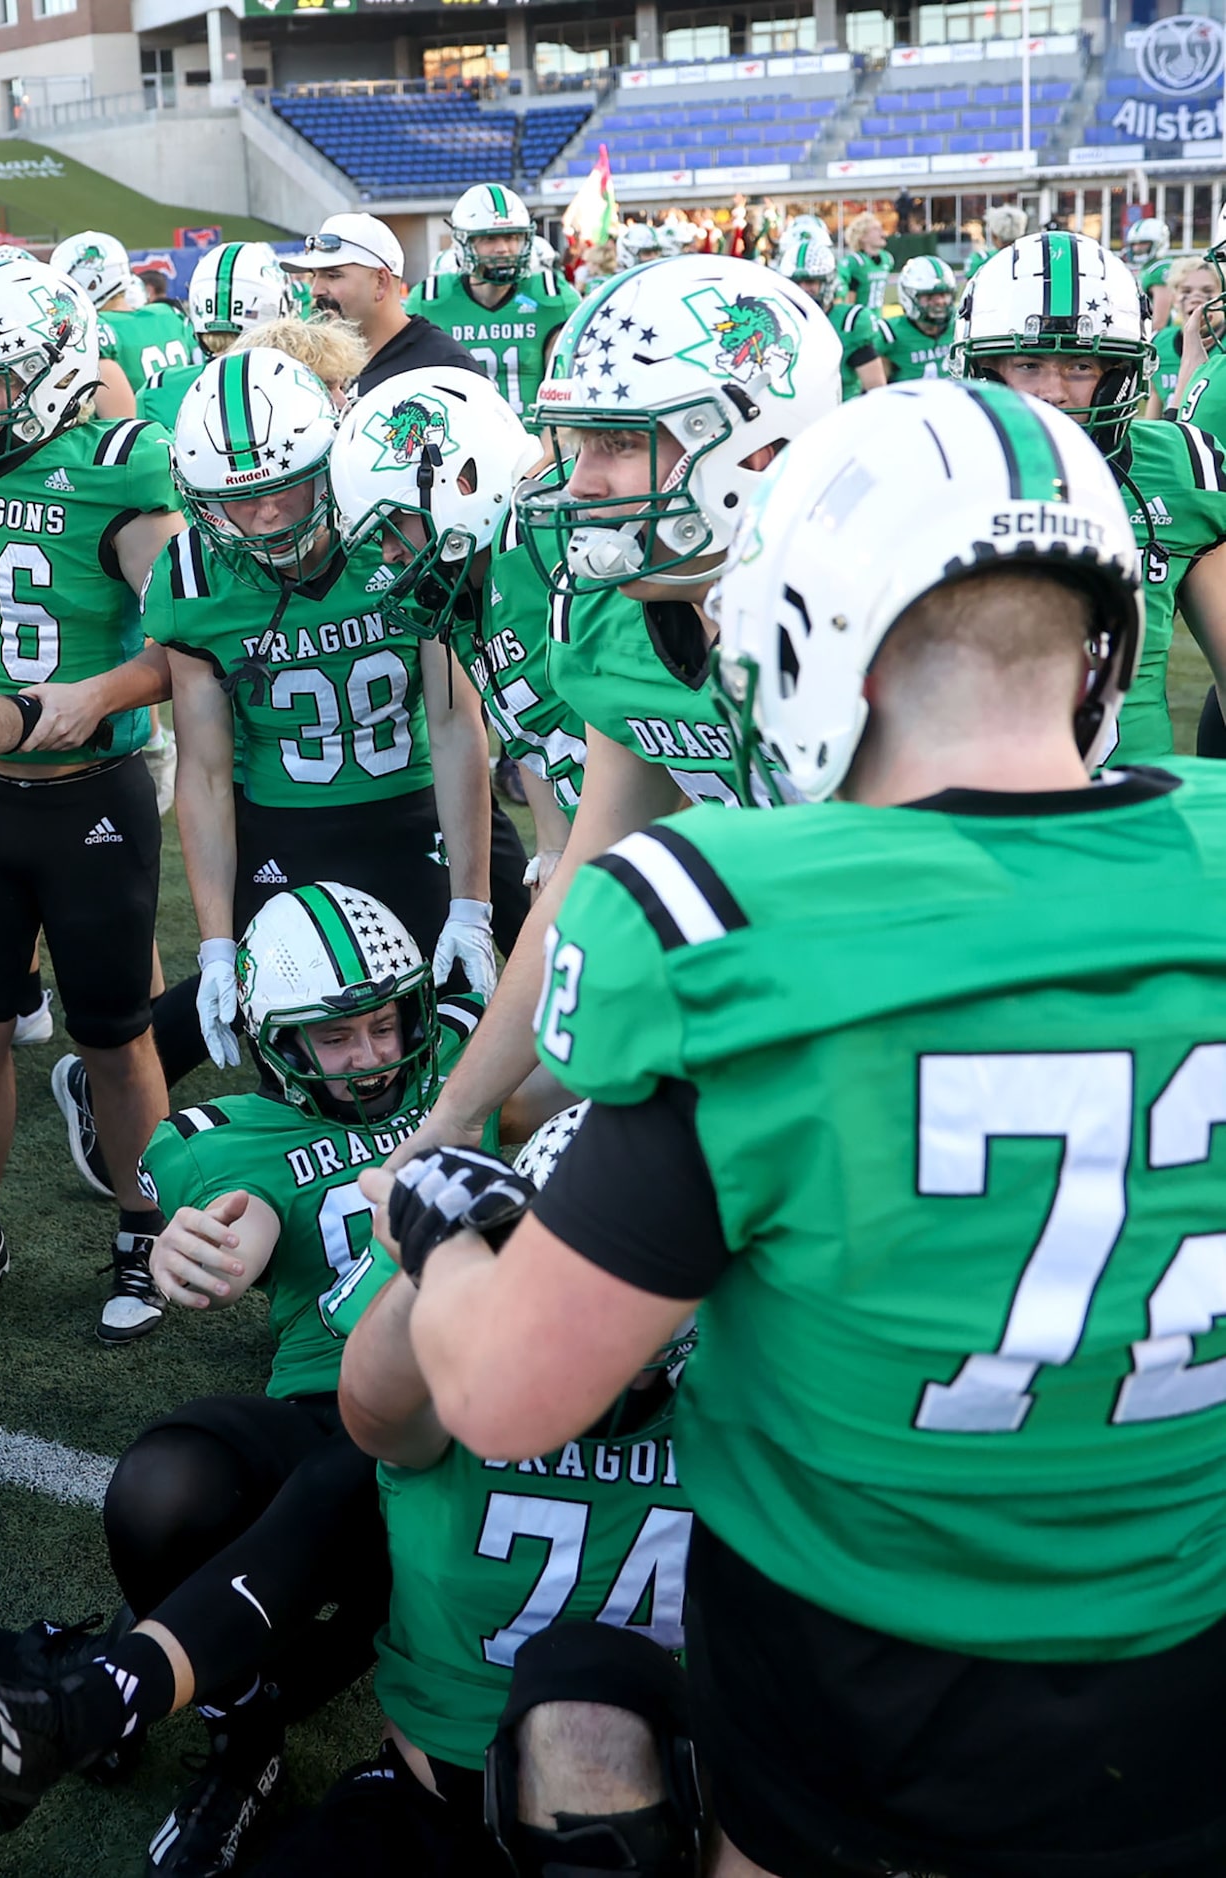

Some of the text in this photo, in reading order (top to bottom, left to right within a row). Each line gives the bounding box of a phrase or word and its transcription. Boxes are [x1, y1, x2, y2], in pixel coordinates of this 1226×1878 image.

[452, 323, 537, 341] DRAGONS
[225, 467, 271, 486] Riddell
[271, 649, 413, 783] 38
[84, 832, 123, 845] adidas
[253, 873, 288, 883] adidas
[476, 1492, 693, 1668] 74
